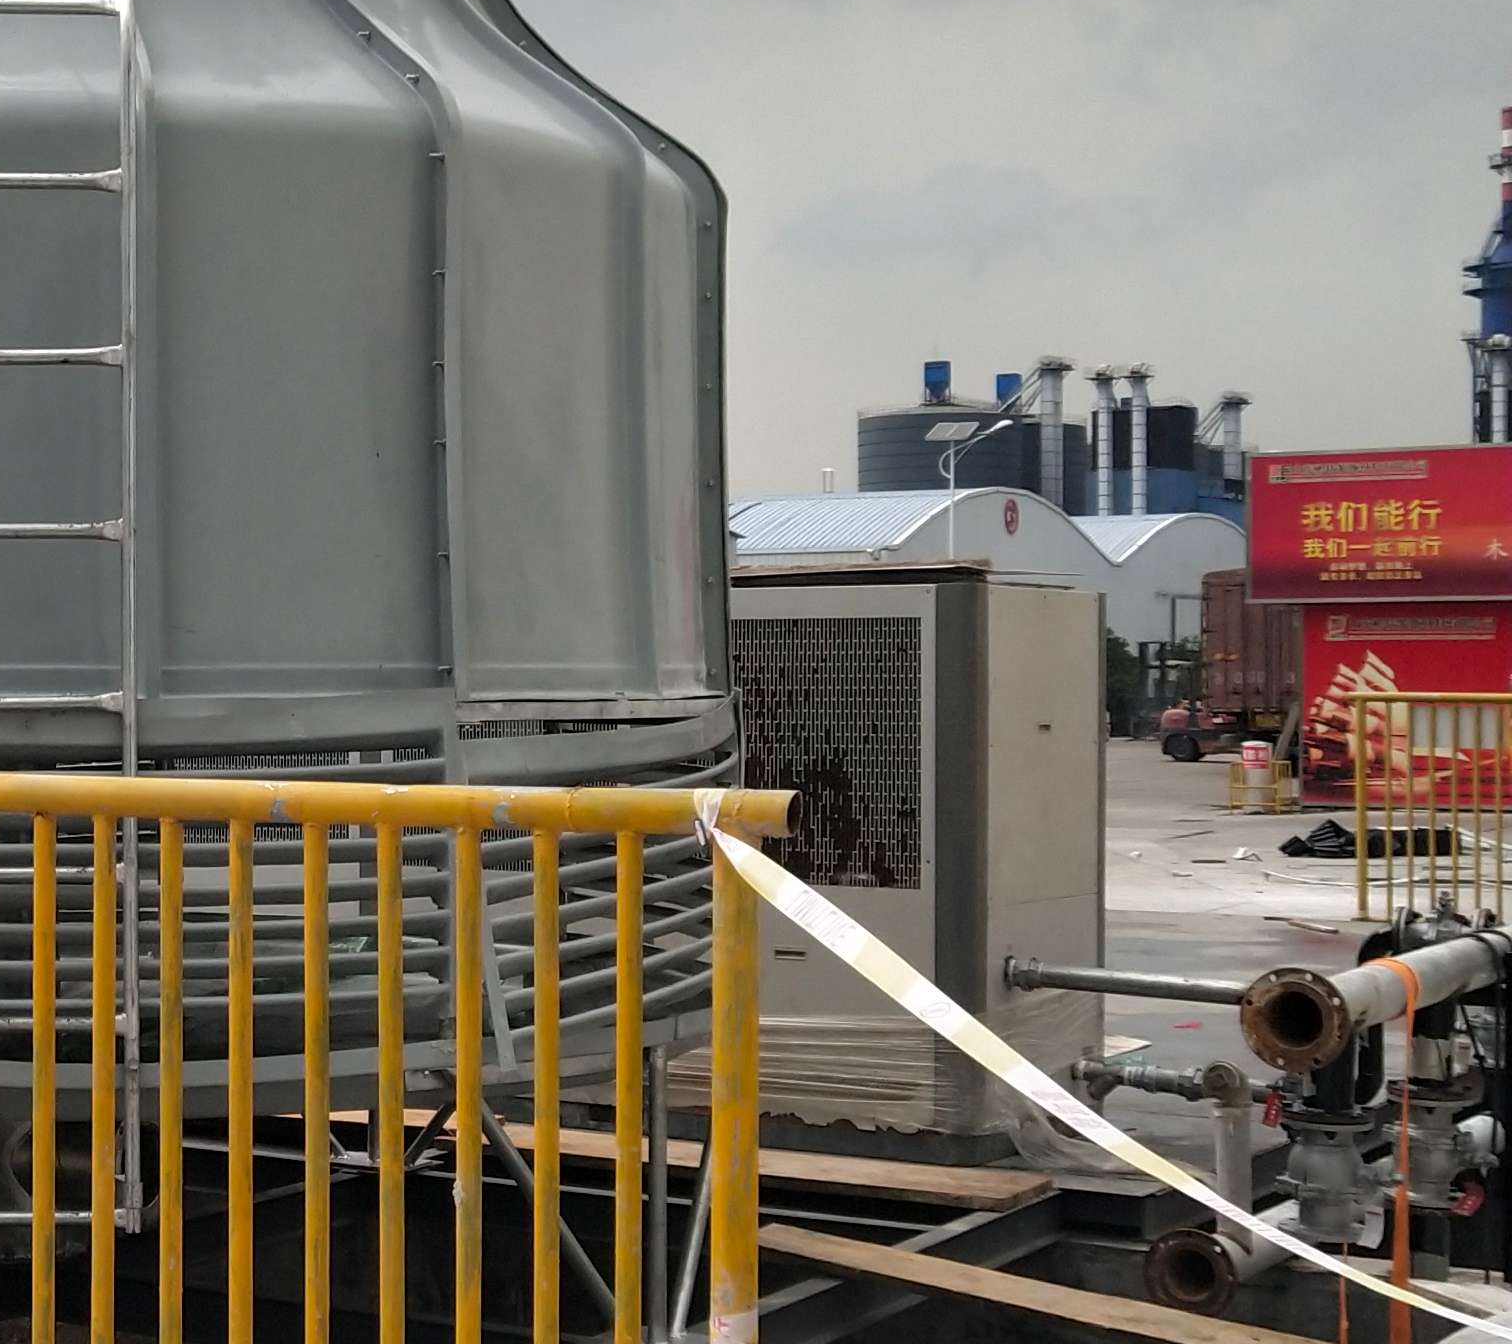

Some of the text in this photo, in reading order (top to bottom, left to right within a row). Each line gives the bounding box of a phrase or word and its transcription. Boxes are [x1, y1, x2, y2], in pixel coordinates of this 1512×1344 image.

[1301, 499, 1443, 532] 我们能行
[1303, 535, 1443, 559] 我们一起前行
